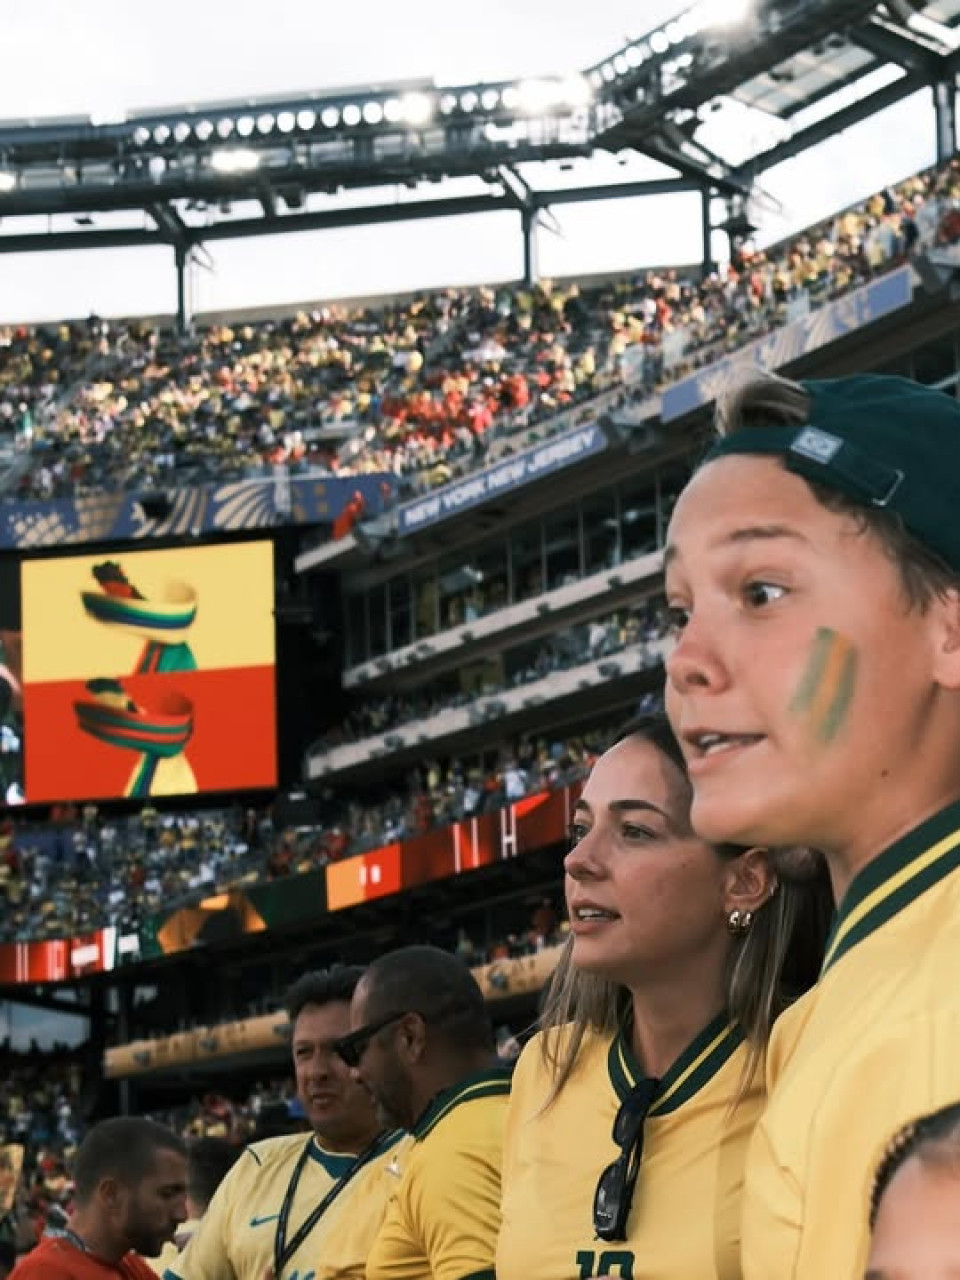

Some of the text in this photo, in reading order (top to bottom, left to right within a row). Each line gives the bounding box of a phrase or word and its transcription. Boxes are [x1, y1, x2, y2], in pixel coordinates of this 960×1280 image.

[404, 429, 596, 526] NEW YORK NEW JERSEY
